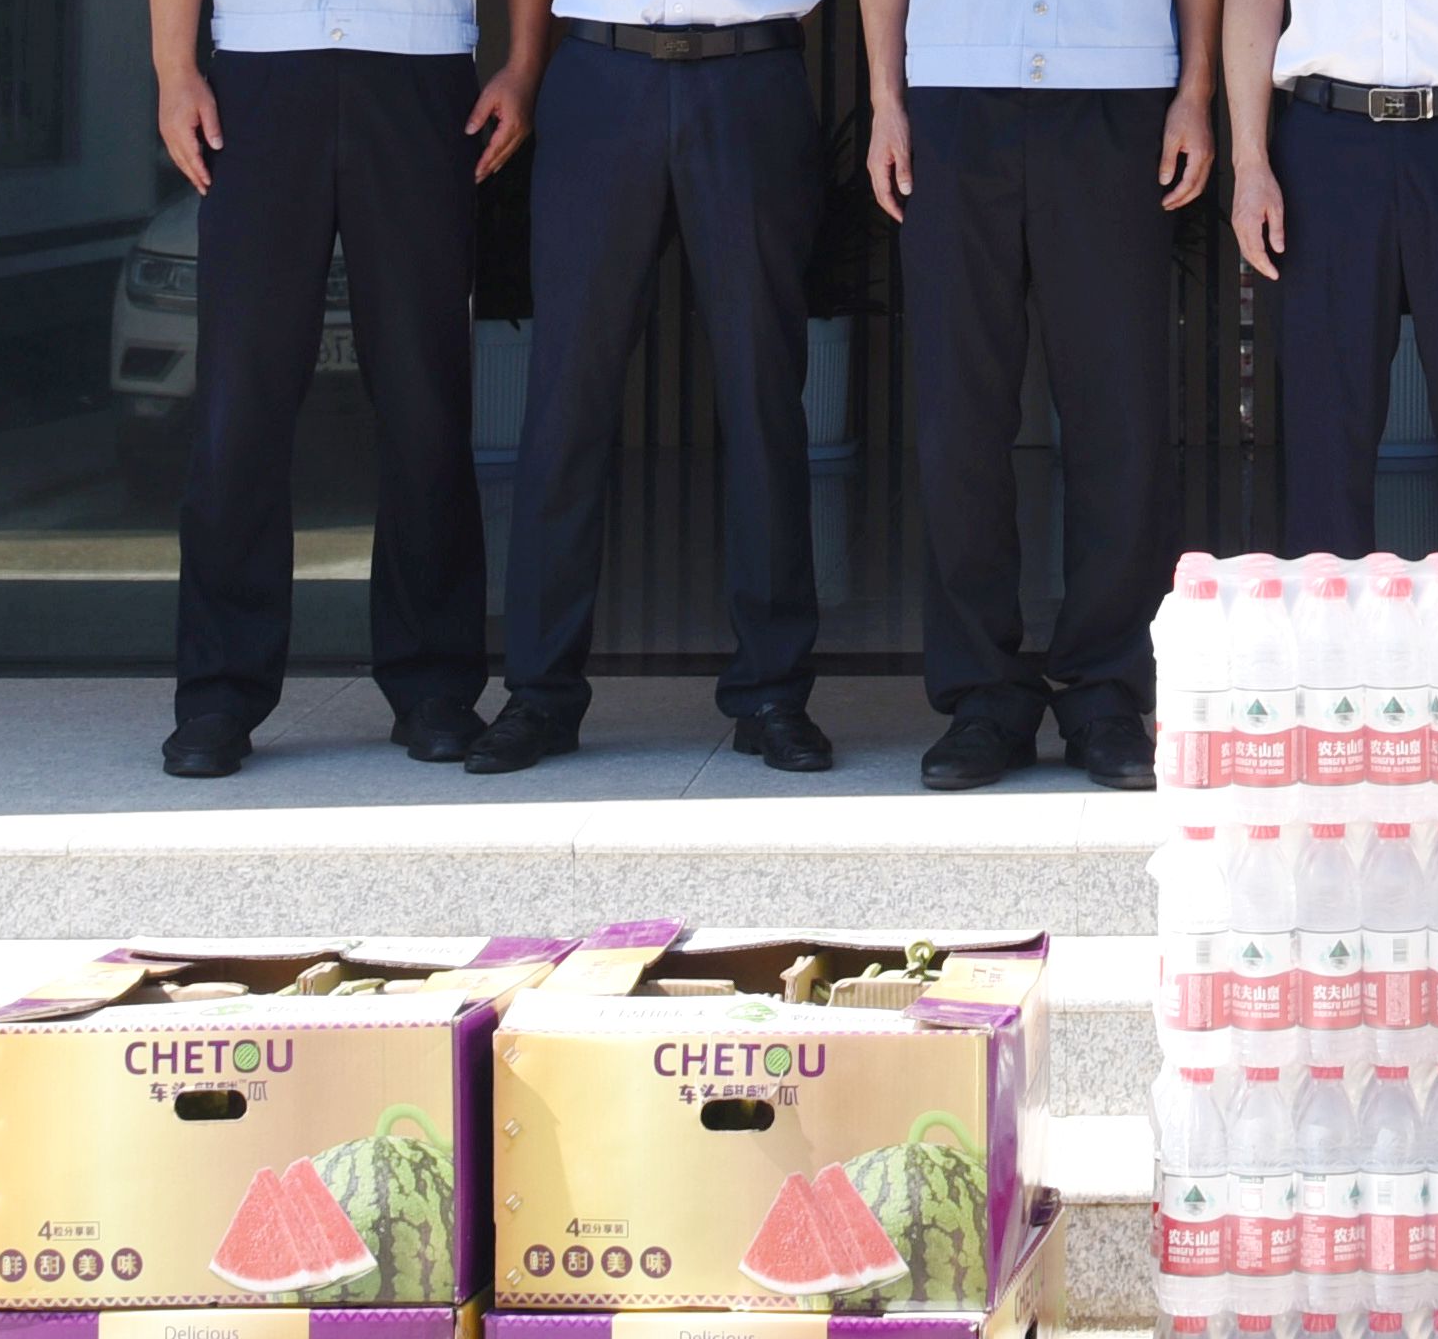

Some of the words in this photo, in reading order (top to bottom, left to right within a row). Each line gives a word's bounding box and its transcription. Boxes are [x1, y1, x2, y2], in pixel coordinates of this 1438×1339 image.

[124, 1038, 294, 1076] CHETOU
[653, 1042, 826, 1078] CHETOU
[0, 1254, 137, 1276] 鲜甜美味
[529, 1250, 666, 1274] 鲜甜美味
[164, 1325, 240, 1339] Delicious
